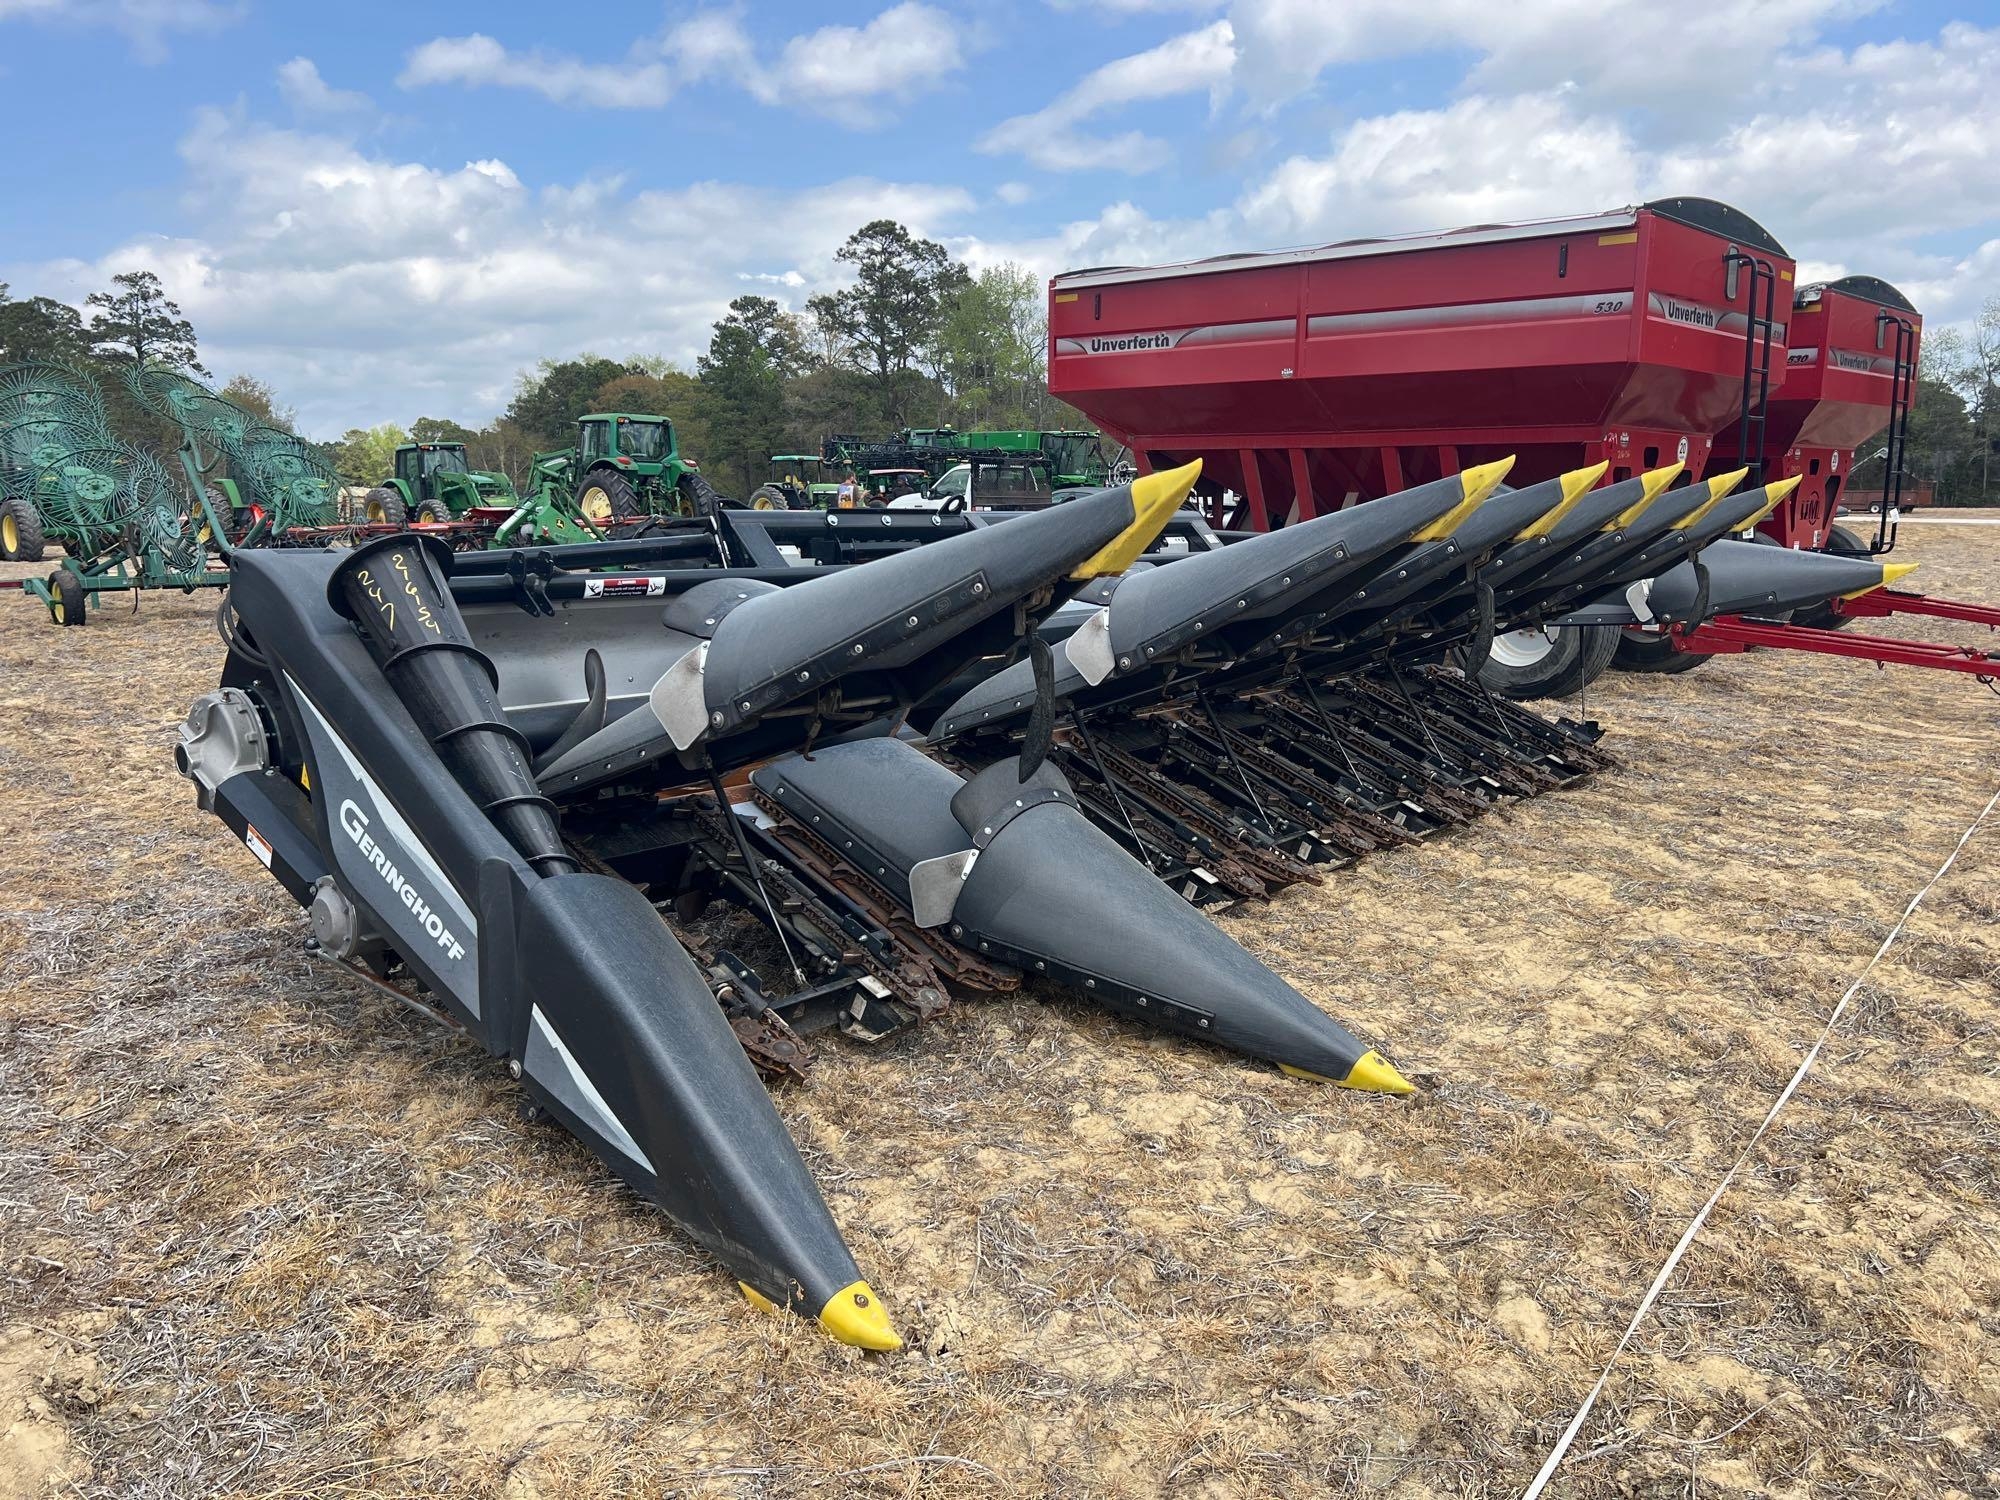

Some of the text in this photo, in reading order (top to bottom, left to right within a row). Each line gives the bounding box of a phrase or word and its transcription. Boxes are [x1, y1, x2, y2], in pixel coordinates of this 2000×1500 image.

[1593, 301, 1623, 314] 530
[1667, 301, 1714, 328] Unverferth
[1091, 333, 1170, 353] Unverferth
[1787, 354, 1809, 365] 530
[1679, 442, 1687, 454] 20
[357, 570, 395, 631] 247
[339, 798, 466, 961] GERINGHOFF
